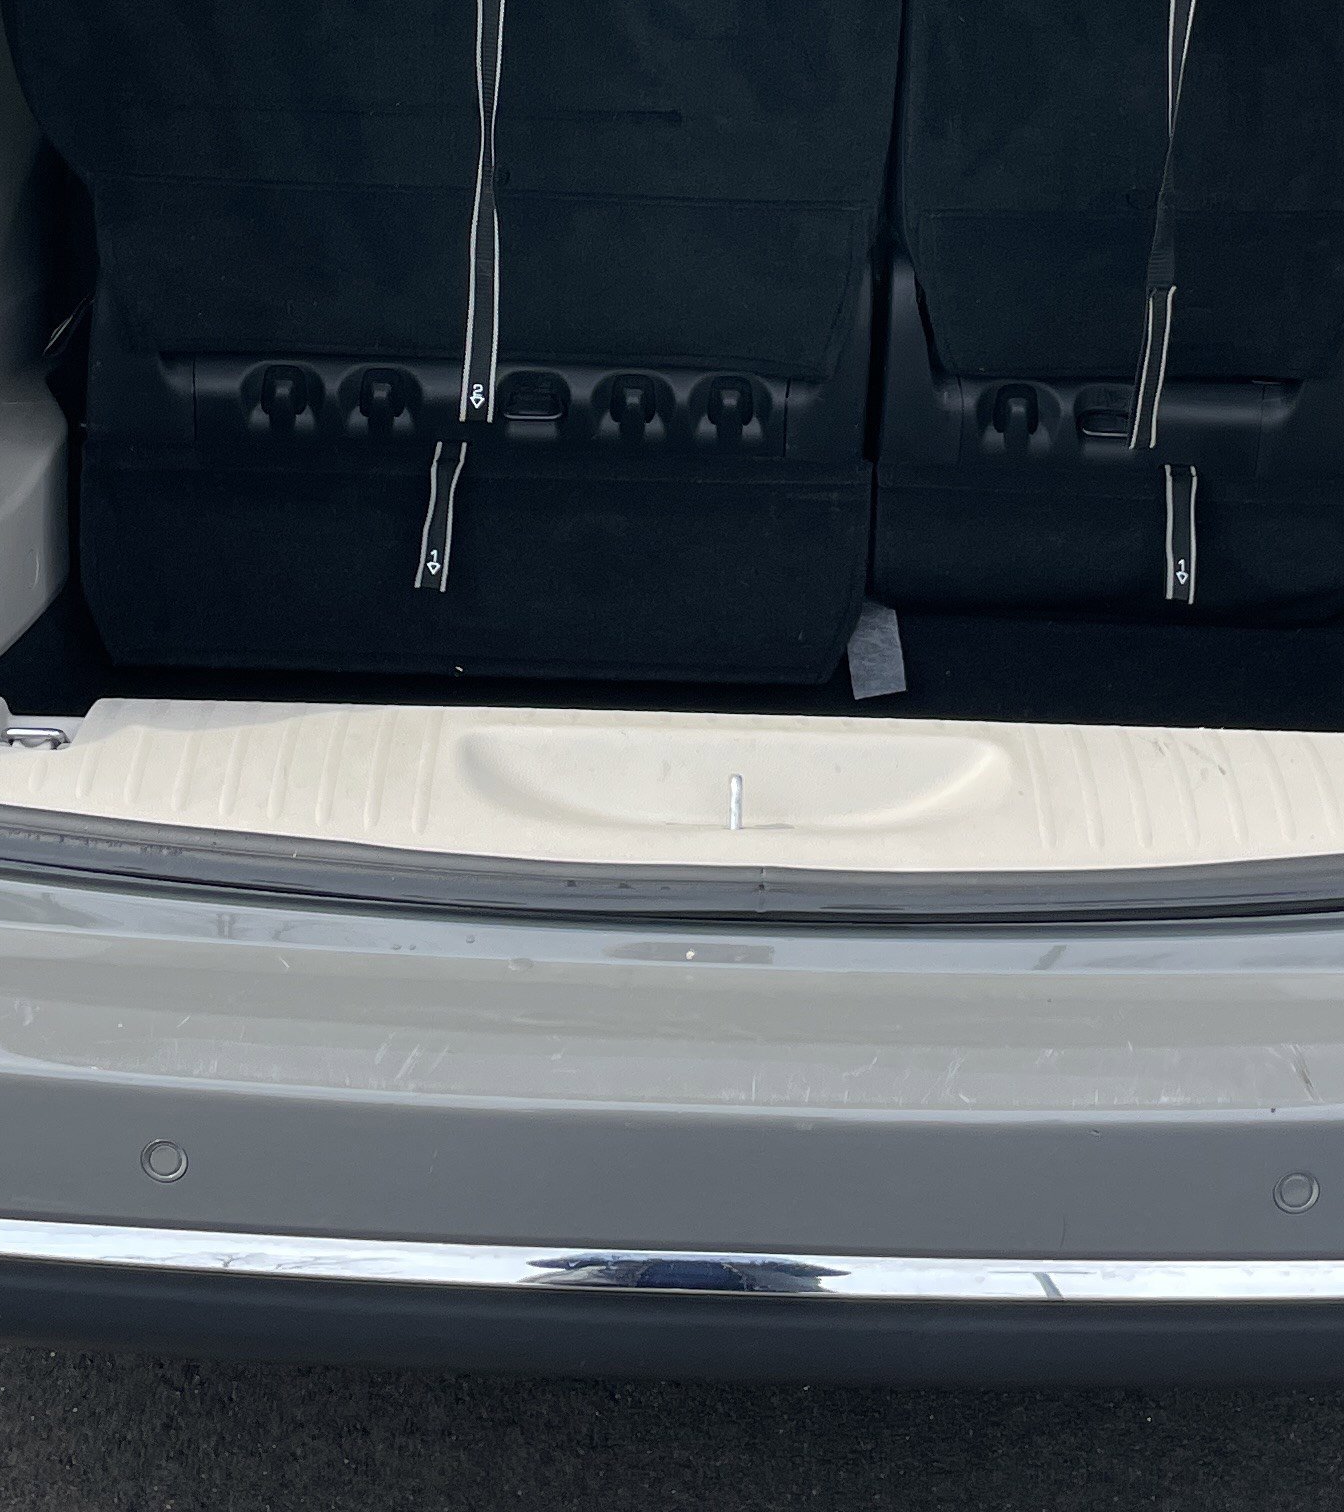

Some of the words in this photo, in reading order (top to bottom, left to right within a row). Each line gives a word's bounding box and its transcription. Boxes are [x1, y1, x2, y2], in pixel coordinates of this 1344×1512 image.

[472, 383, 484, 397] 2
[430, 549, 438, 563] 1
[1177, 558, 1185, 572] 1
